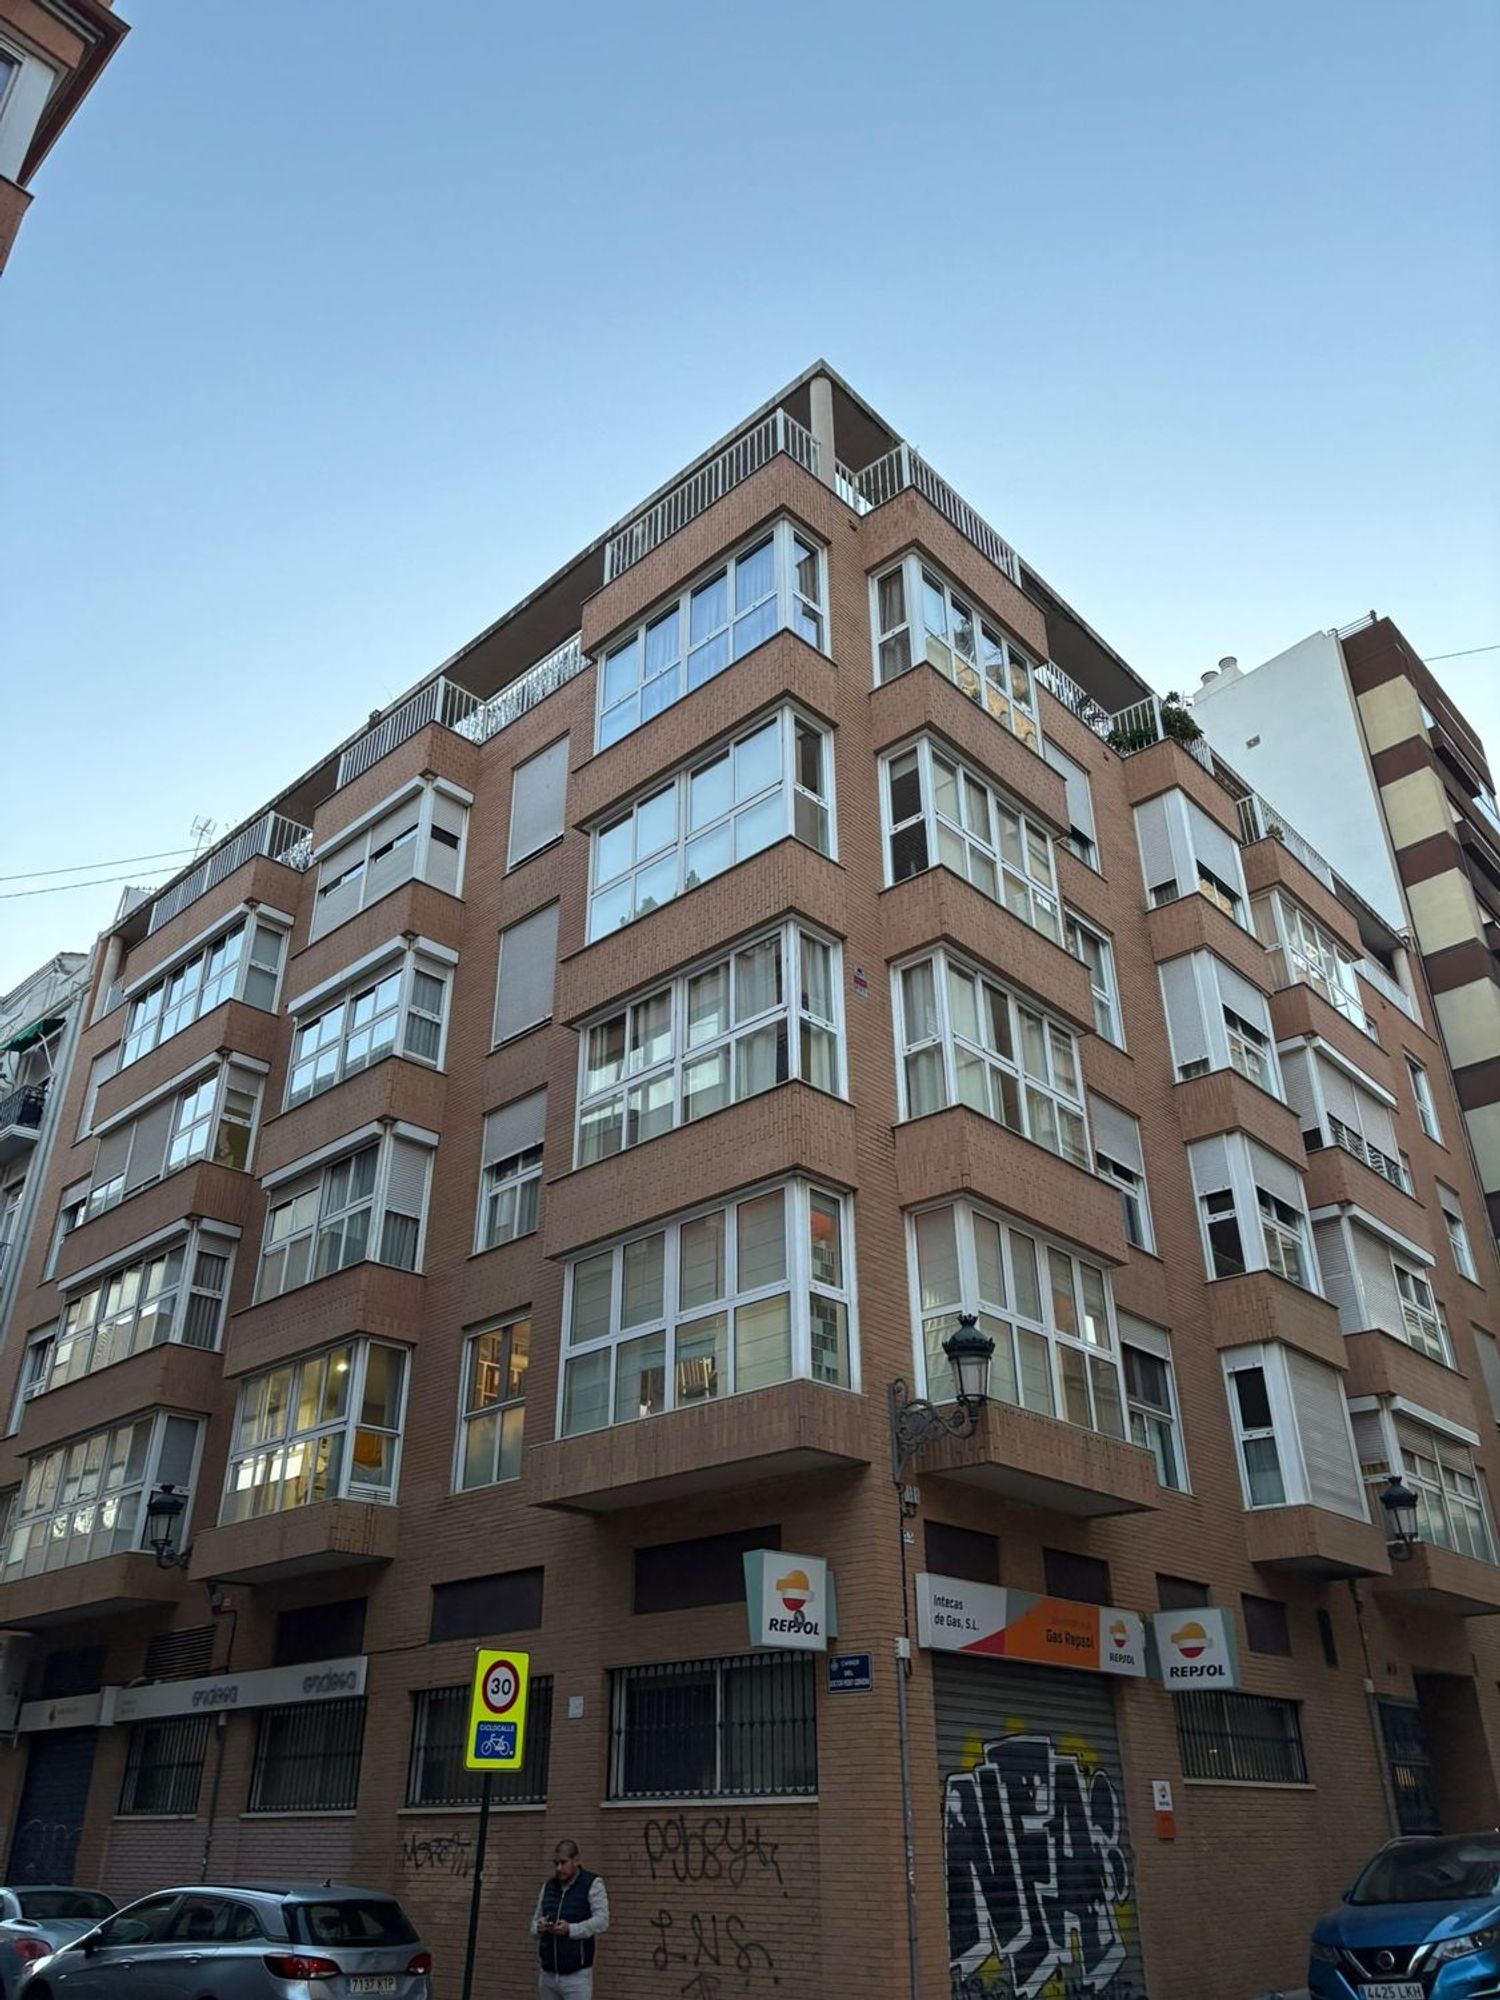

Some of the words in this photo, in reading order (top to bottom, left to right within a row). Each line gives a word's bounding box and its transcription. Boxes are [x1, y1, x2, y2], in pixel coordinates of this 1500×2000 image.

[933, 1593, 964, 1610] Intecas
[934, 1613, 945, 1626] de
[768, 1618, 820, 1636] REPSOL
[1046, 1628, 1063, 1644] Gas
[1064, 1631, 1095, 1650] Repsol
[1109, 1652, 1135, 1665] REPSOL
[1169, 1664, 1226, 1678] REPSOL
[490, 1677, 512, 1695] 30
[479, 1724, 515, 1732] CICLOCALLE
[1367, 1985, 1396, 1999] 4425
[1397, 1985, 1423, 1999] LKH
